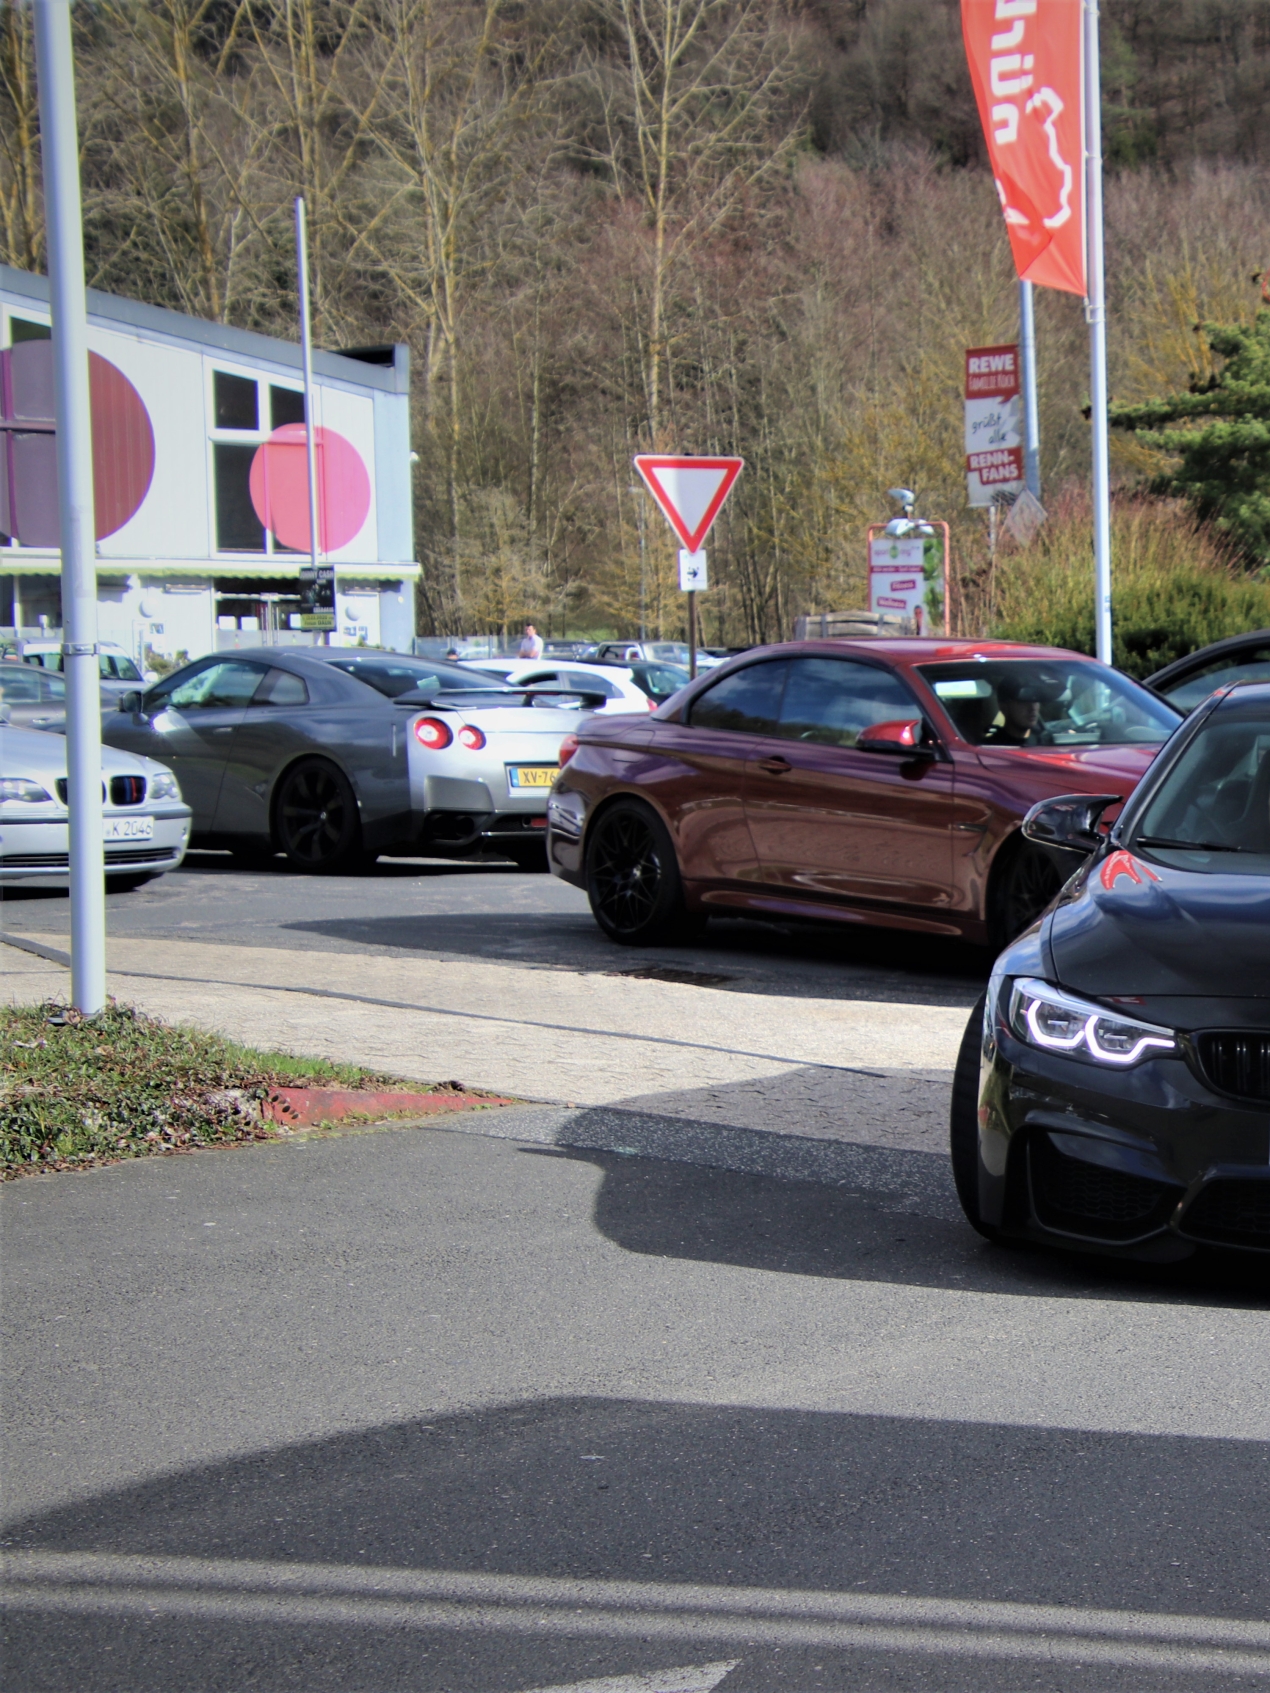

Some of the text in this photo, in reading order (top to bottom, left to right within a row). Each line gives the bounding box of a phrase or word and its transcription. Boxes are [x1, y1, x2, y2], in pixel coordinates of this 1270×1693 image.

[969, 354, 1014, 373] REWE
[970, 450, 1015, 469] RENN-
[982, 464, 1018, 482] FANS
